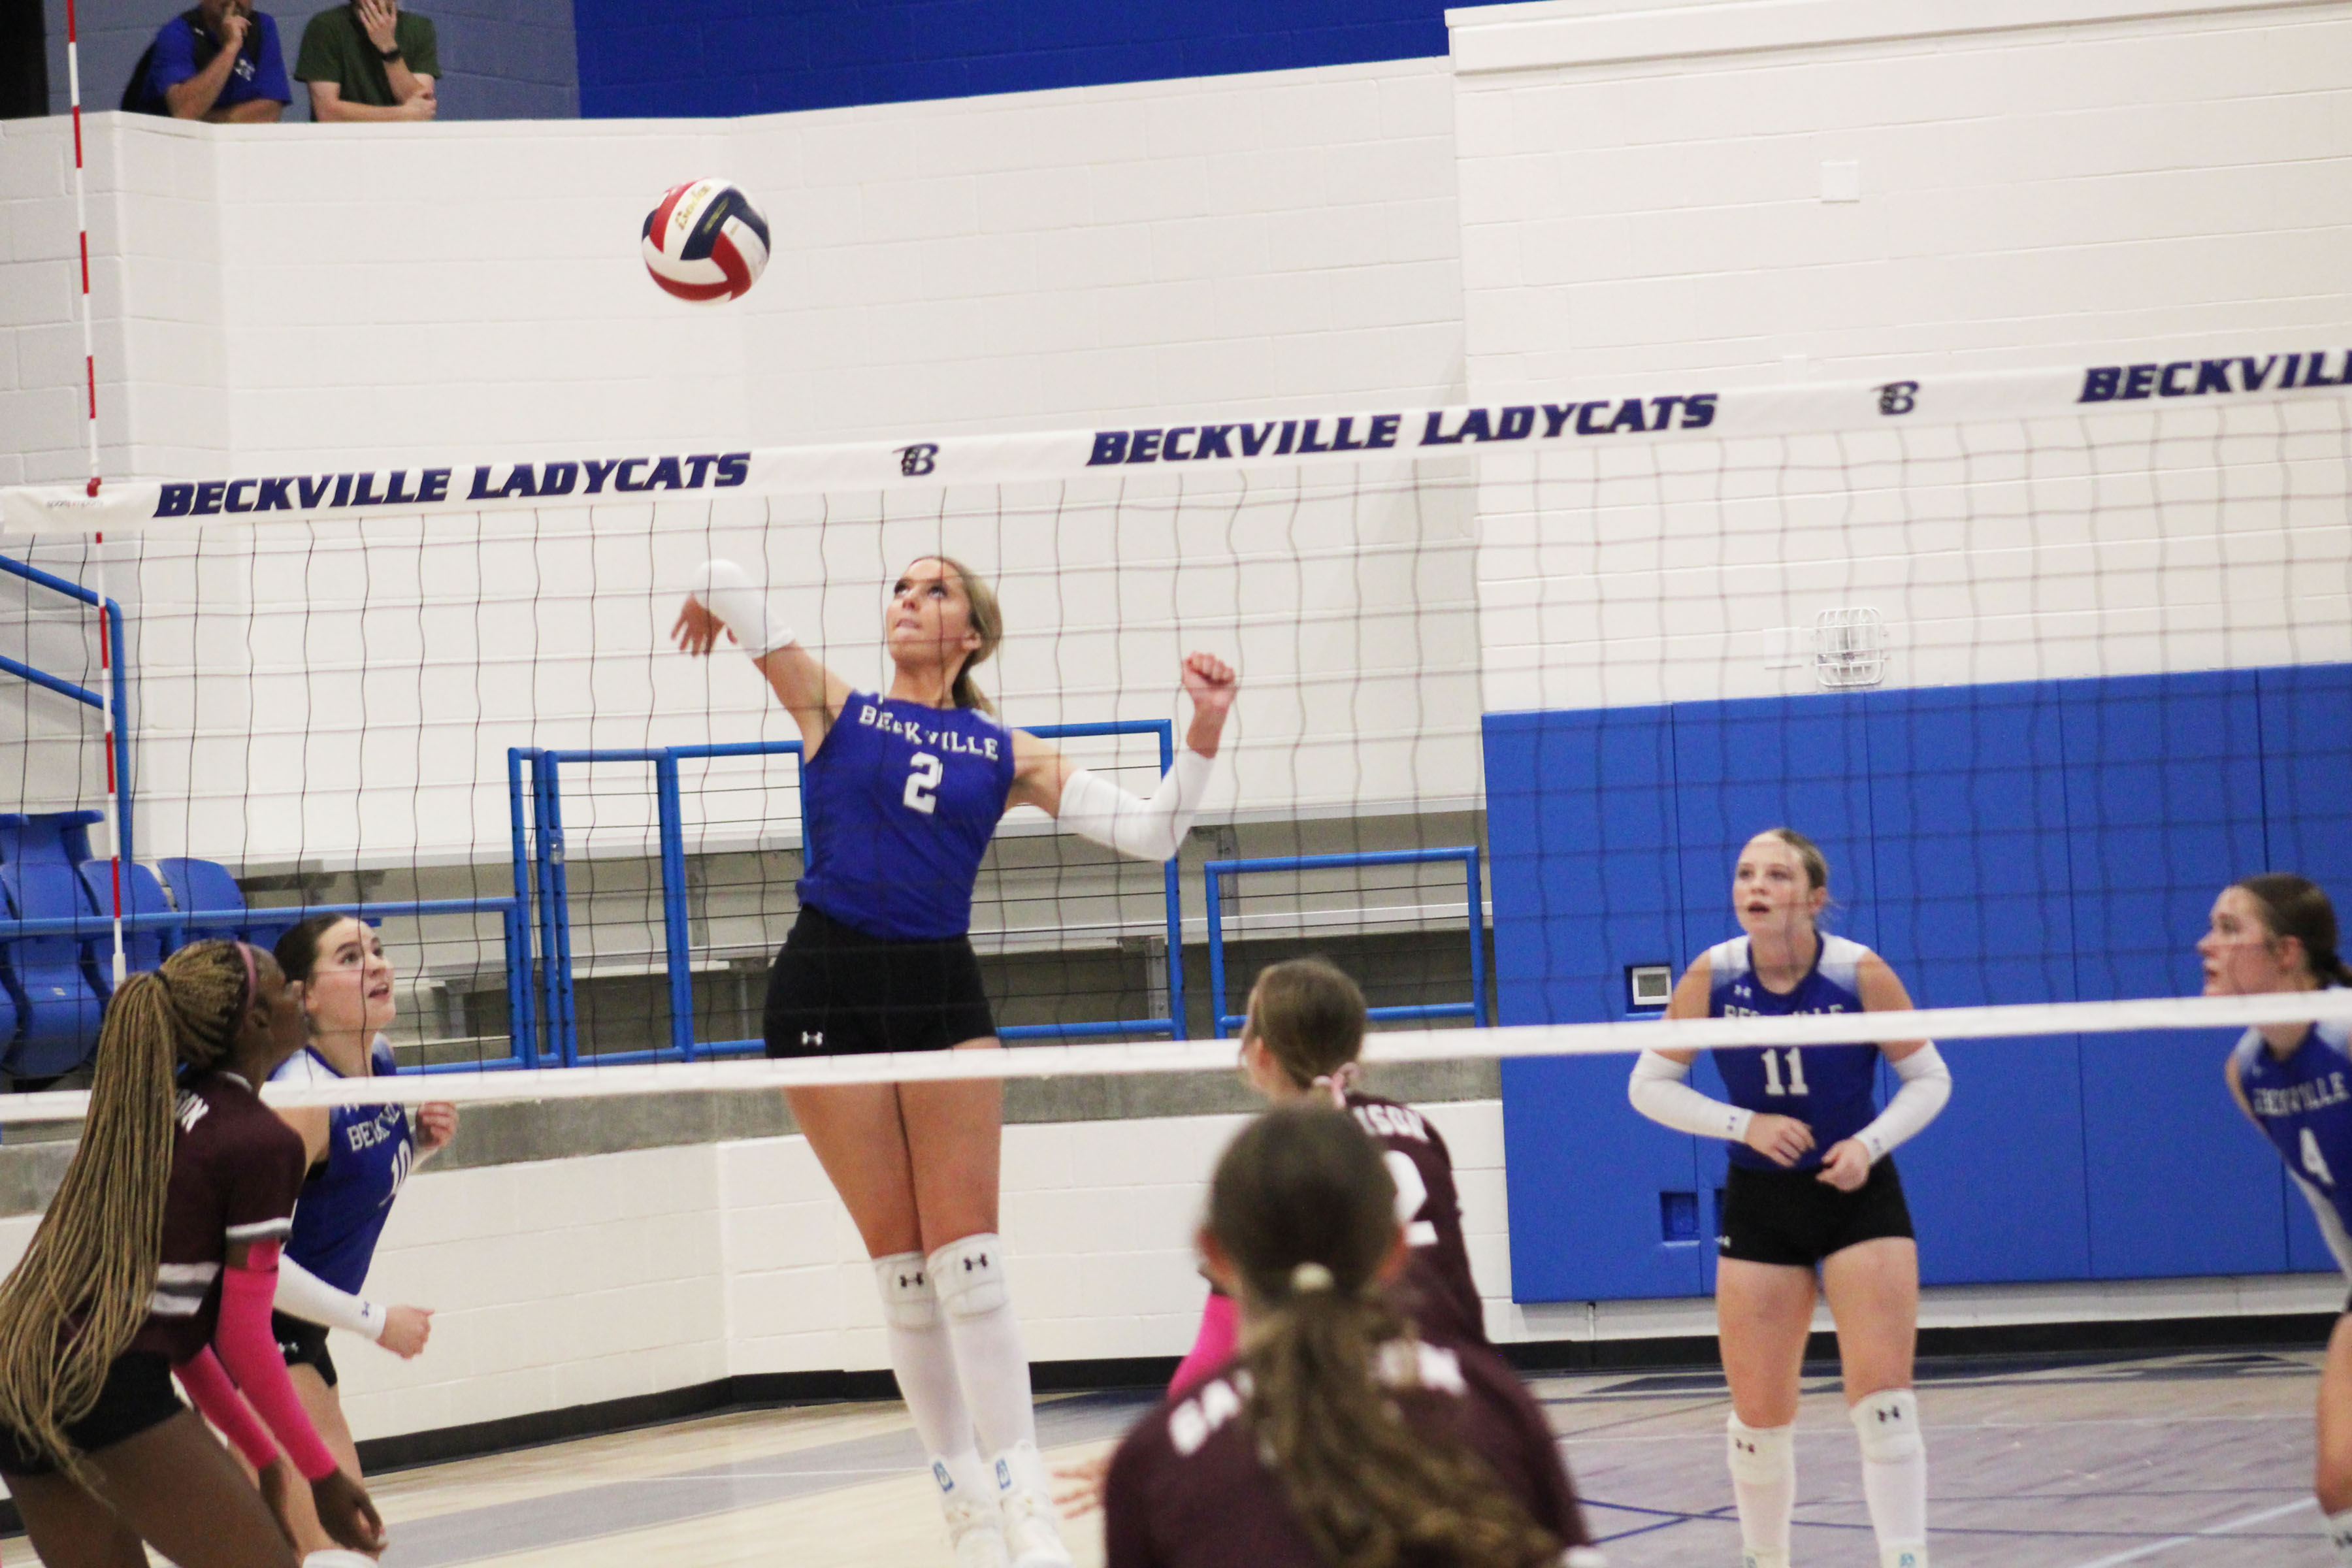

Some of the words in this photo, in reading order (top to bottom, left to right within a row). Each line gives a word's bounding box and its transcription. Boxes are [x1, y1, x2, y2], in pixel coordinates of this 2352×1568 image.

[2077, 350, 2352, 403] BECKVIL
[1085, 414, 1401, 466] BECKVILLE
[1418, 393, 1718, 446] LADYCATS
[152, 467, 452, 518] BECKVILLE
[466, 451, 751, 500] LADYCATS
[903, 751, 943, 813] 2
[1761, 1047, 1808, 1095] 11
[1352, 1104, 1429, 1143] ISON
[378, 1138, 414, 1209] 10
[2299, 1125, 2336, 1186] 4
